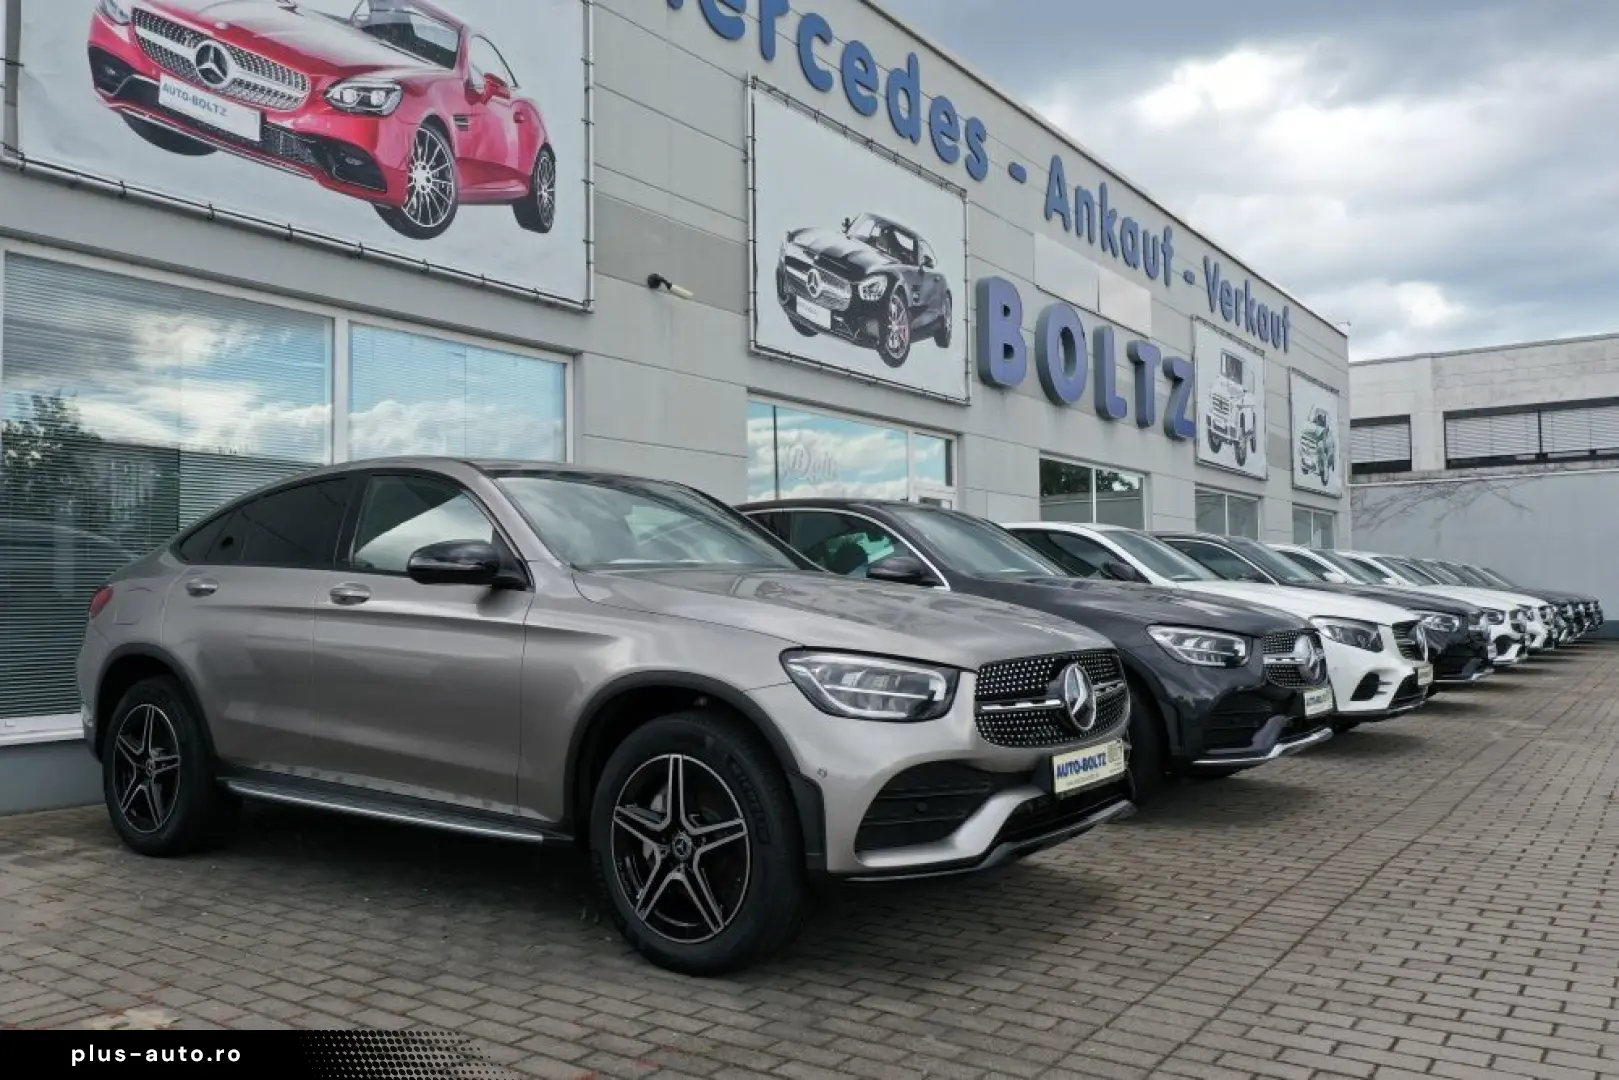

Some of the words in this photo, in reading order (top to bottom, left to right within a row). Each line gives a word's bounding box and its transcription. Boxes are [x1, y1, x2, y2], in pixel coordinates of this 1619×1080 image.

[162, 83, 227, 116] AUTO-BOLTZ
[666, 0, 988, 182] ercedes
[1044, 154, 1174, 287] Ankauf
[1203, 256, 1291, 353] Verkauf
[976, 275, 1197, 442] BOLTZ
